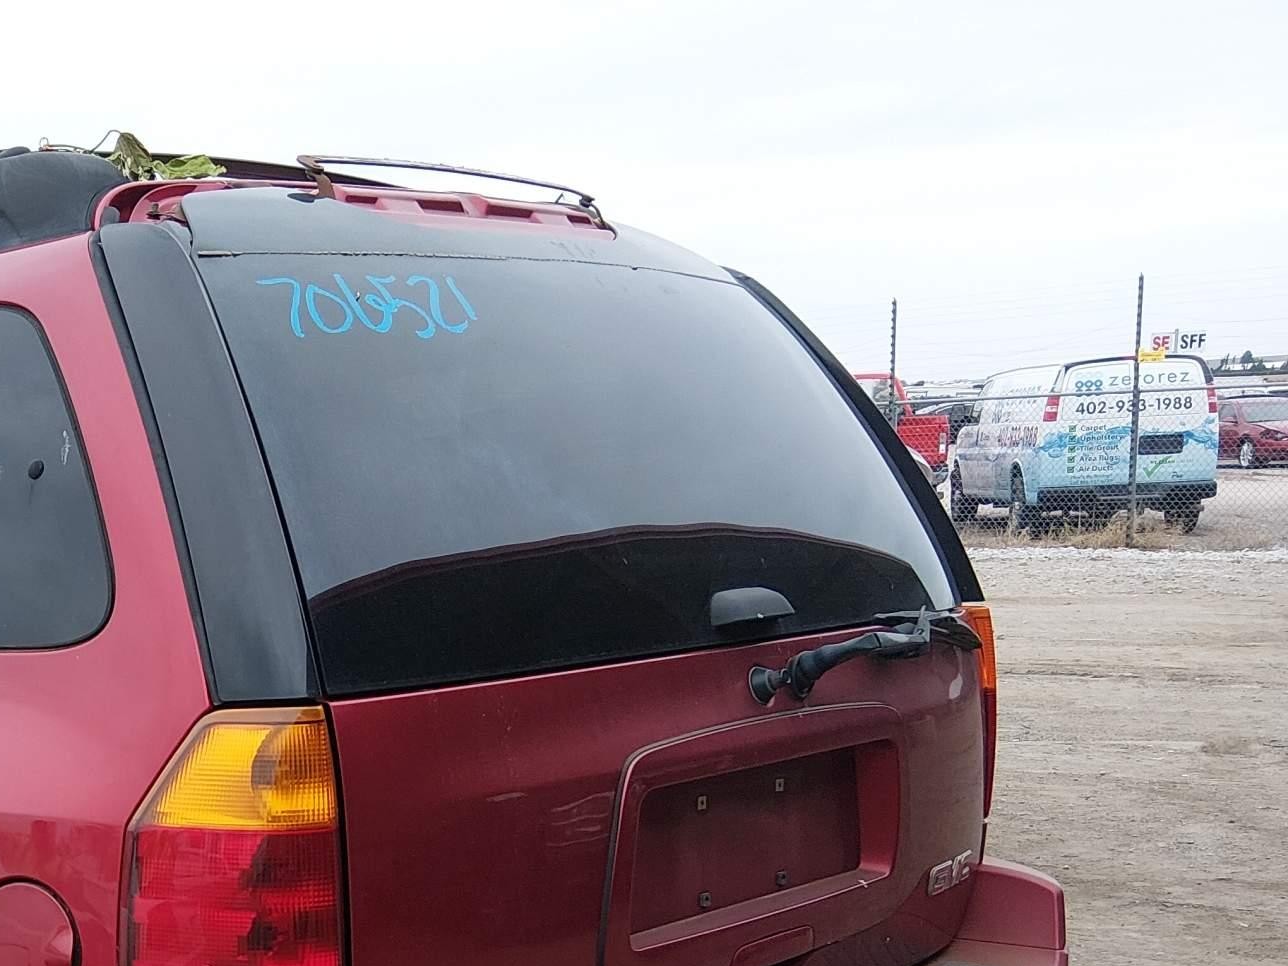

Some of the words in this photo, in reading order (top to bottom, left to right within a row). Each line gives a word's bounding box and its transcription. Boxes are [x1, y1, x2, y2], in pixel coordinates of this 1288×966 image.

[256, 272, 478, 339] 706521
[1180, 333, 1207, 350] SFF
[1109, 371, 1190, 387] zeorez
[1080, 424, 1107, 432] Carpet
[1080, 434, 1123, 443] Upholstery
